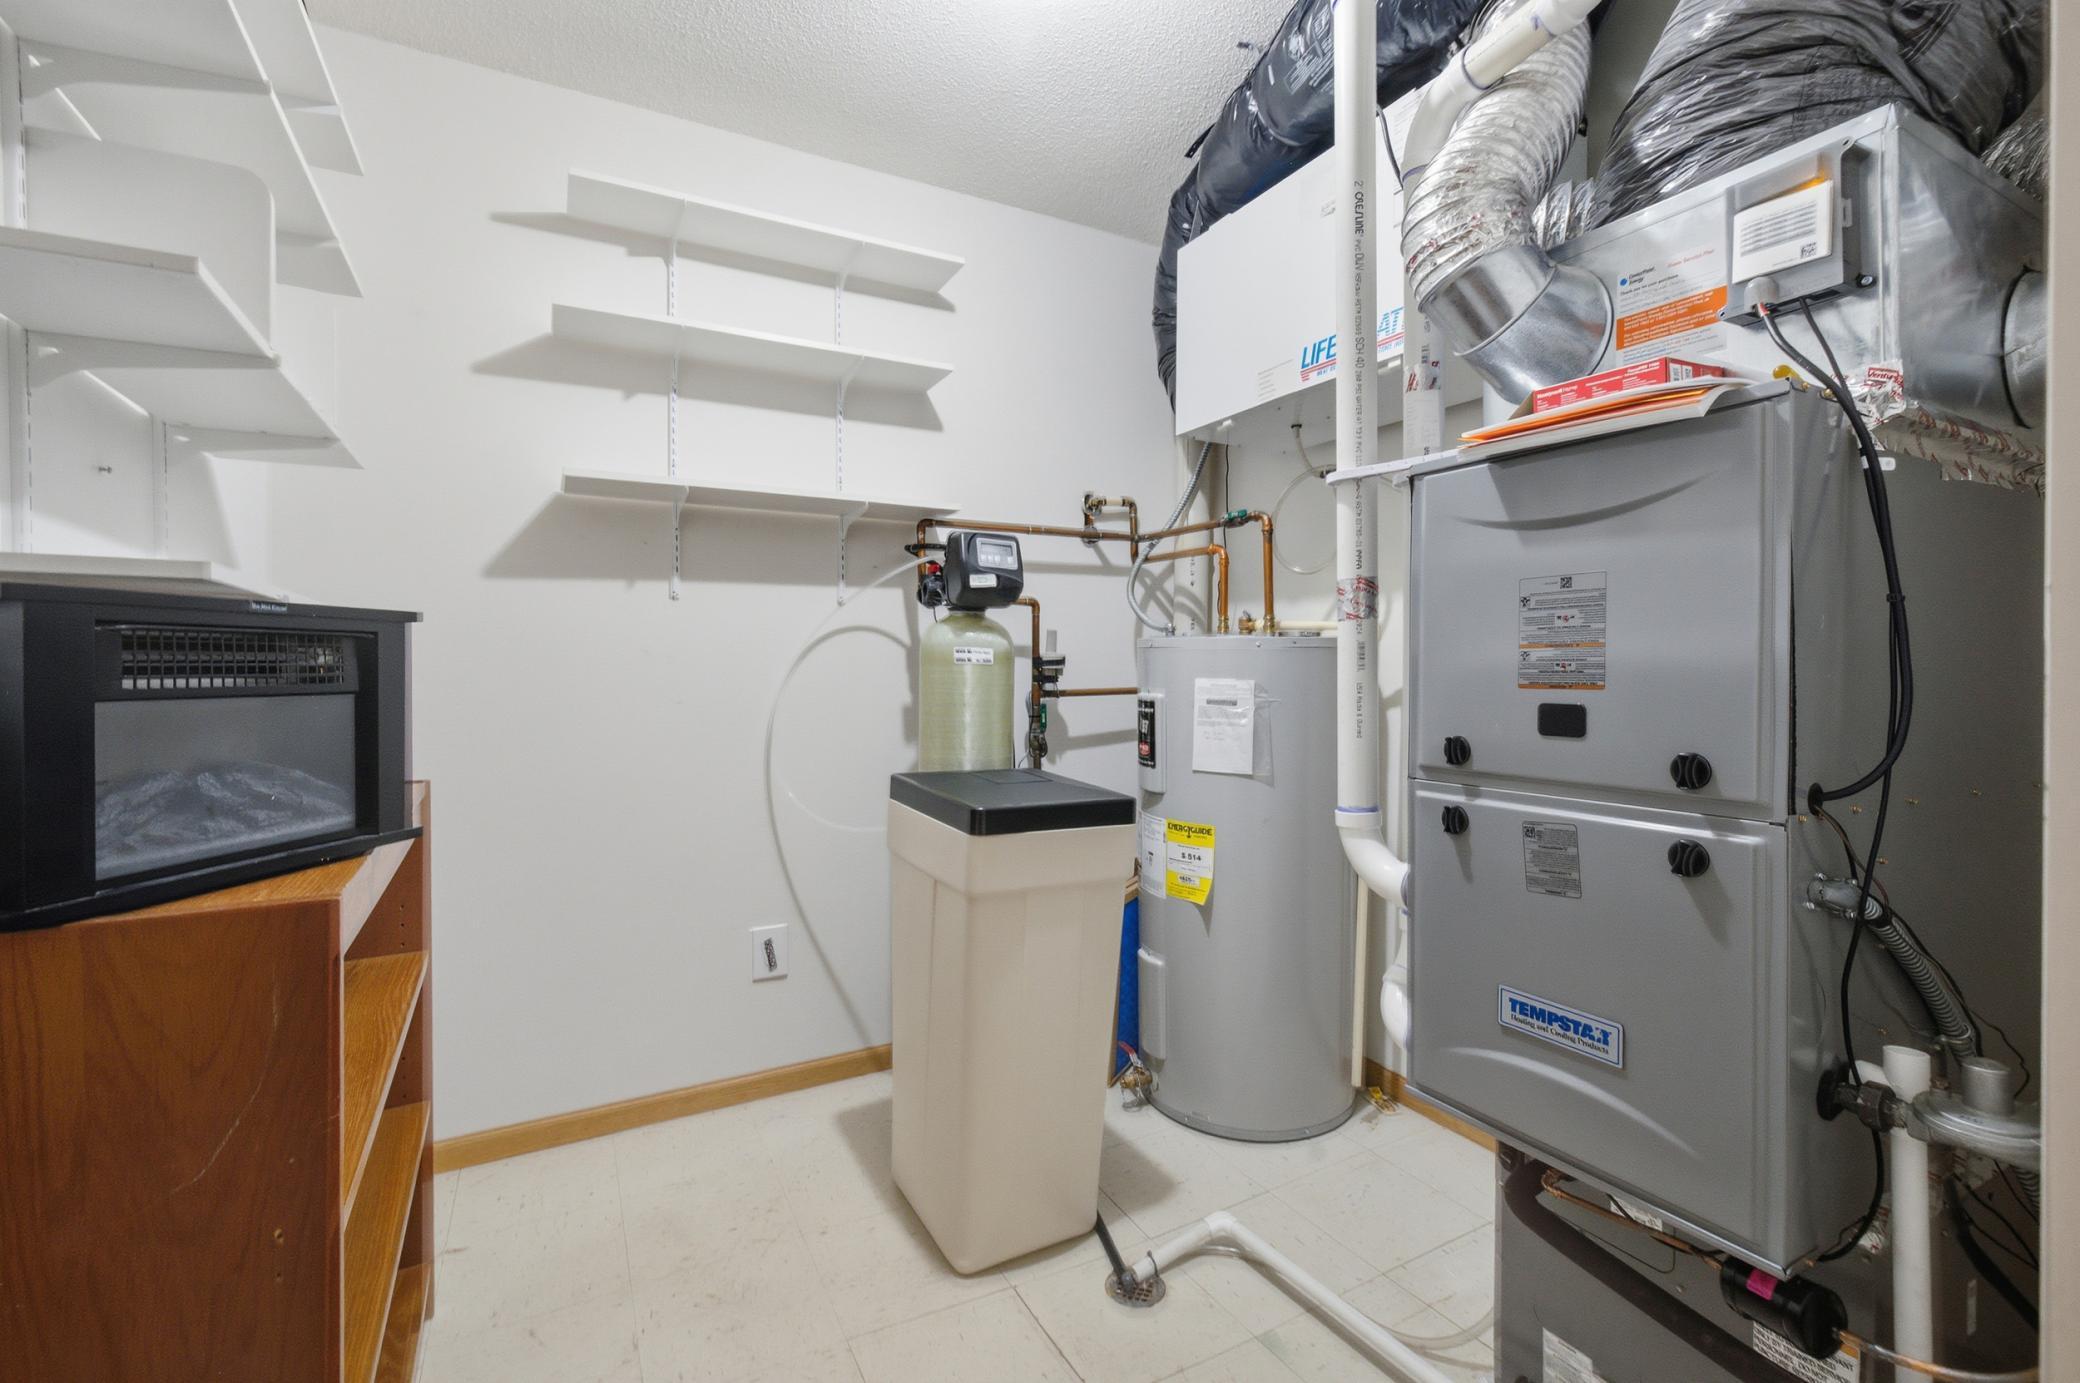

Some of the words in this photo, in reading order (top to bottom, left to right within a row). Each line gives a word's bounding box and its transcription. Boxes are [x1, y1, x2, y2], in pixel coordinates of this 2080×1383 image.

[1354, 336, 1365, 354] SCH
[1354, 356, 1366, 369] 40
[1509, 997, 1612, 1046] TEMPSTAR
[1511, 1013, 1536, 1030] Heating
[1550, 1028, 1577, 1045] Cooling
[1577, 1037, 1609, 1055] Products
